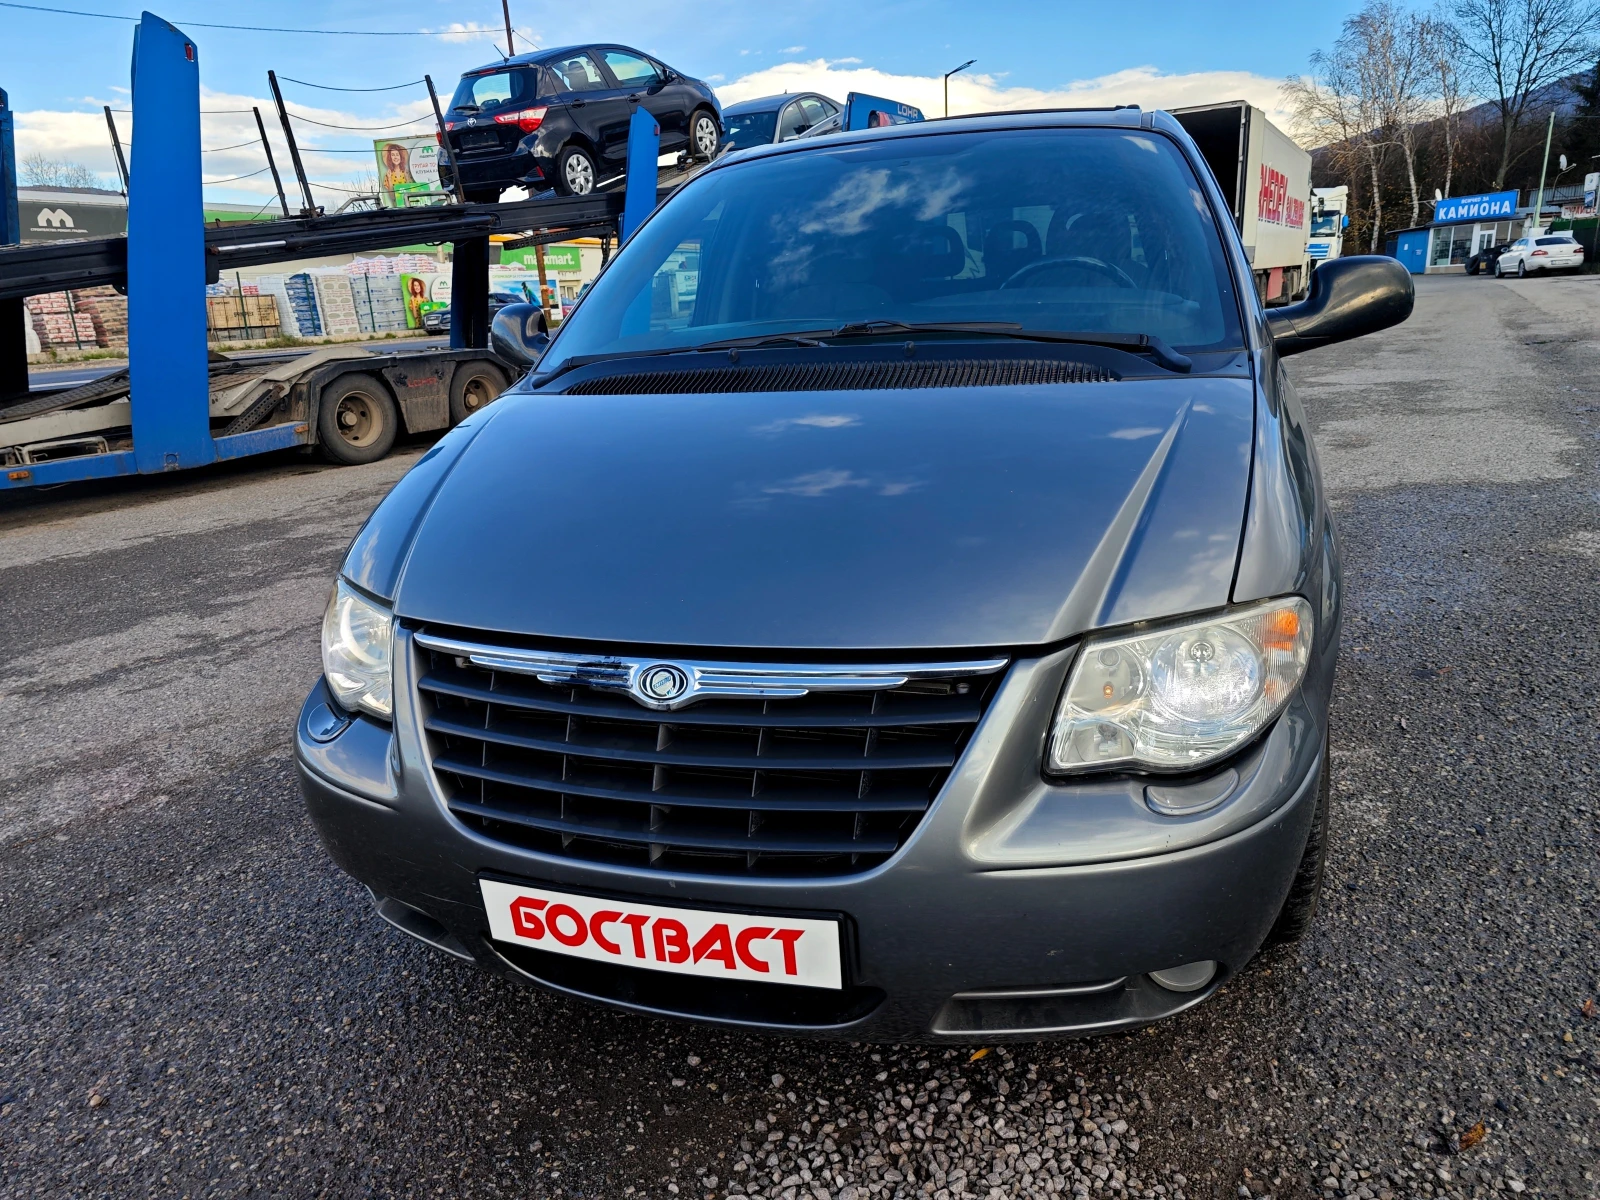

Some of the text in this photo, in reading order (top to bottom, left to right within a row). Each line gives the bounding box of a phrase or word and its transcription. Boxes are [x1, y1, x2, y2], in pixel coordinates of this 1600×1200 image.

[897, 103, 918, 119] LOHR
[1438, 200, 1511, 220] КАМИОНА
[509, 895, 806, 976] БОСТВАСТ
